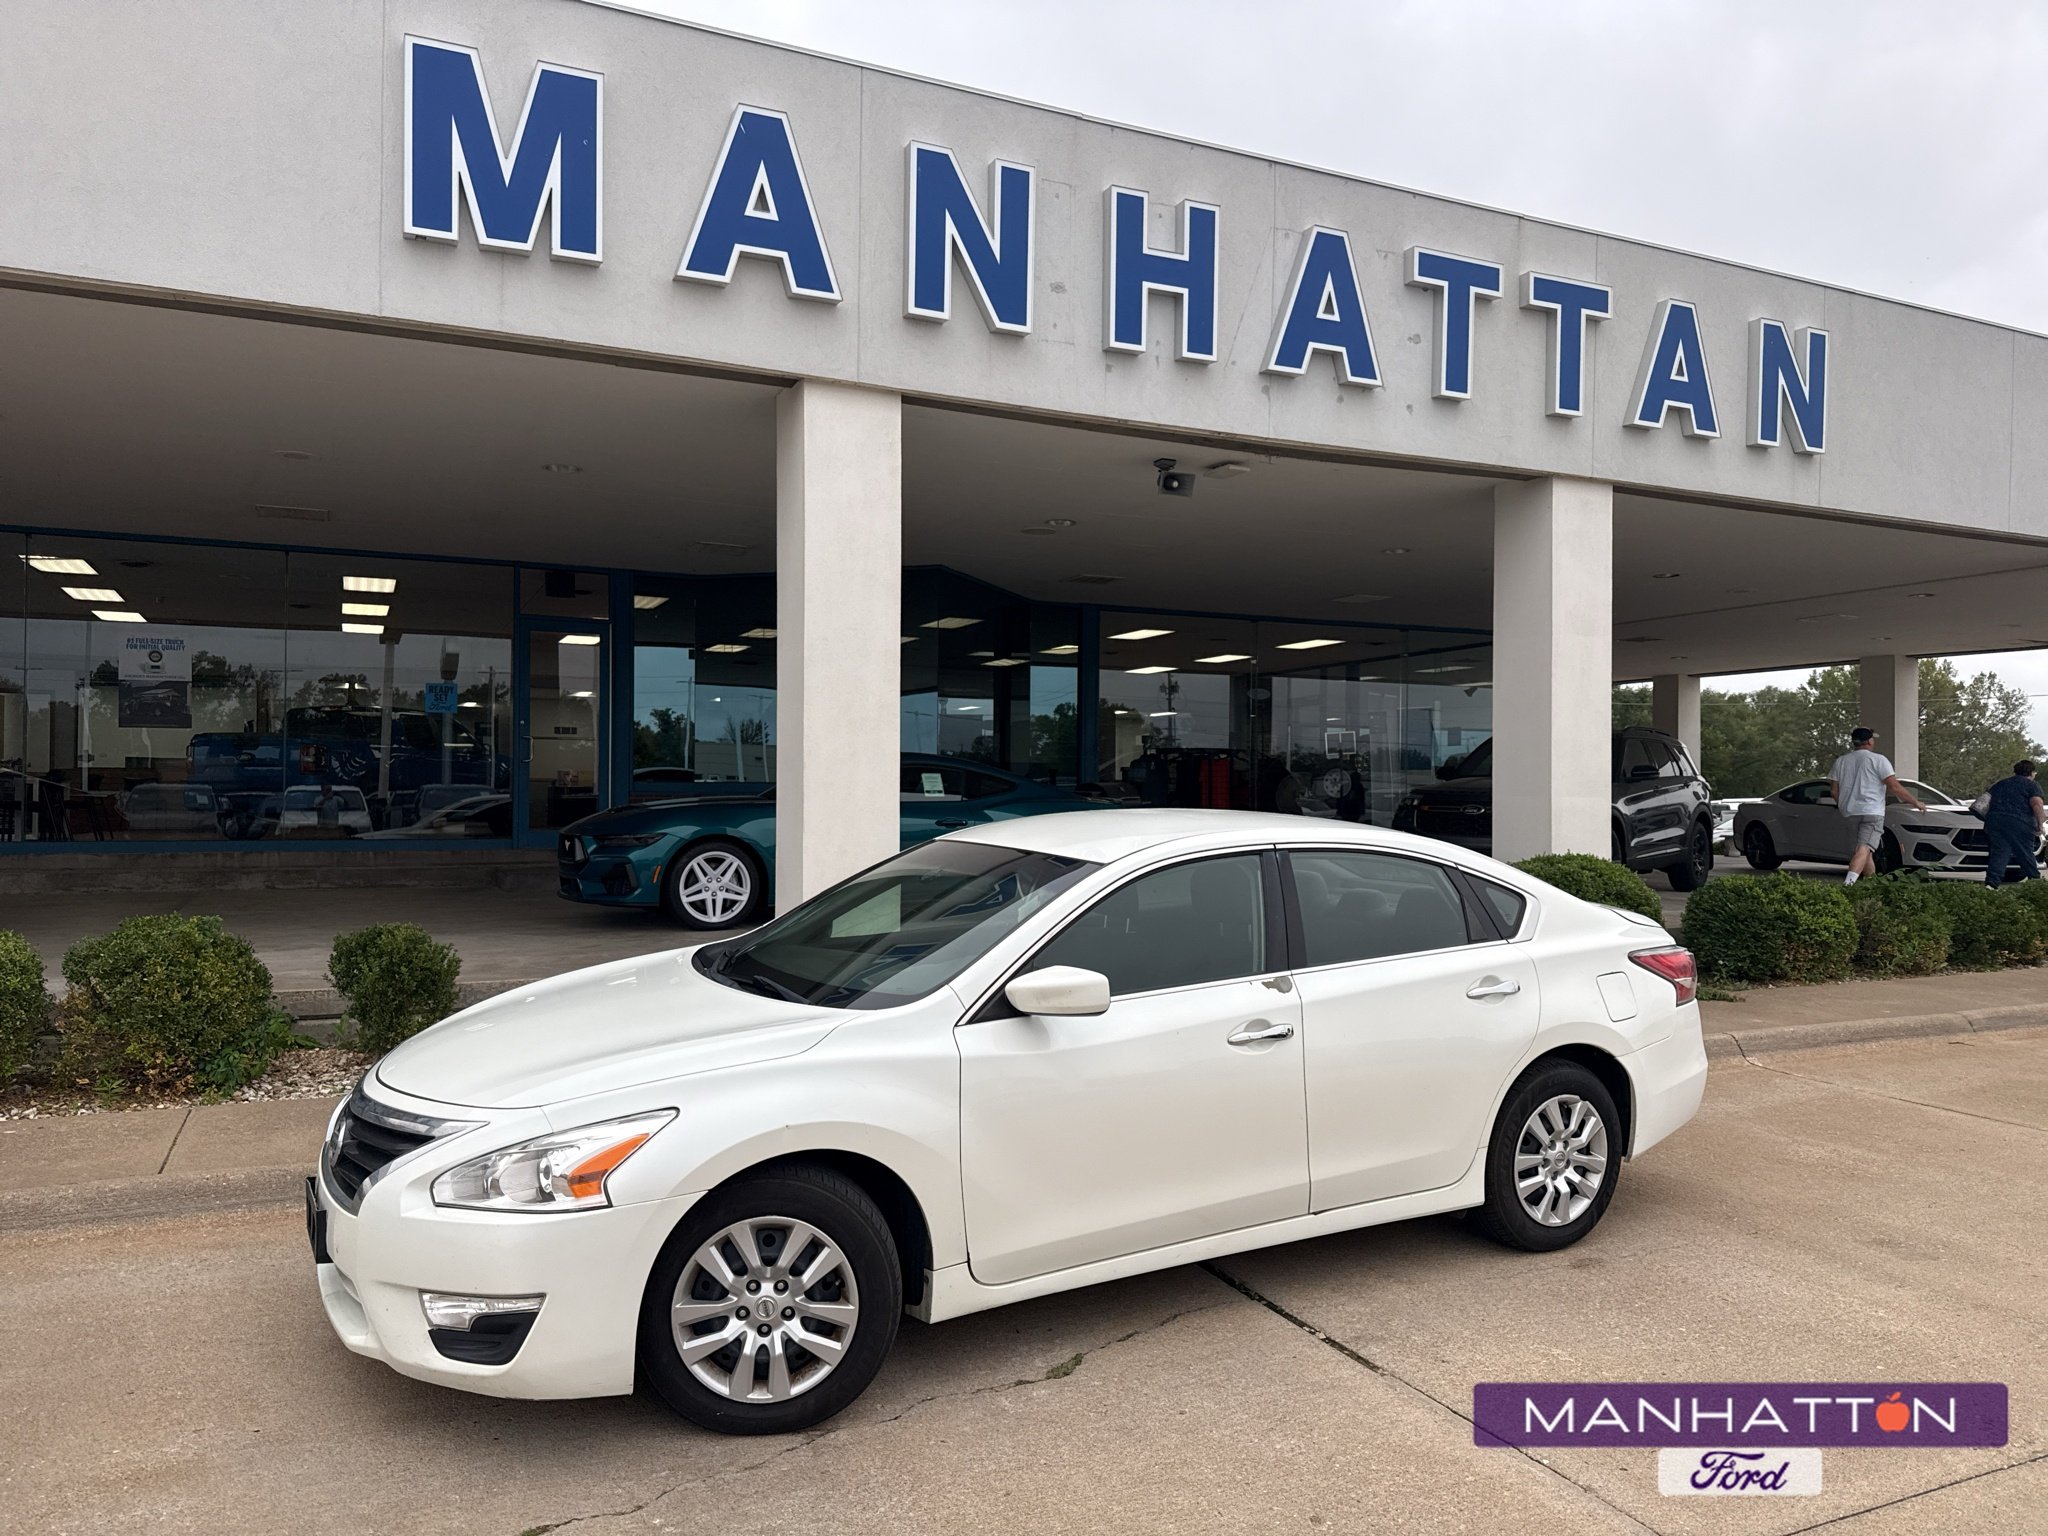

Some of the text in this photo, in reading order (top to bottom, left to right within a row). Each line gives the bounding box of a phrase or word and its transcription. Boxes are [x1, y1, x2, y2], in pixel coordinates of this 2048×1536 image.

[402, 34, 1830, 456] MANHATTAN
[428, 685, 455, 694] READY
[433, 693, 448, 701] SET
